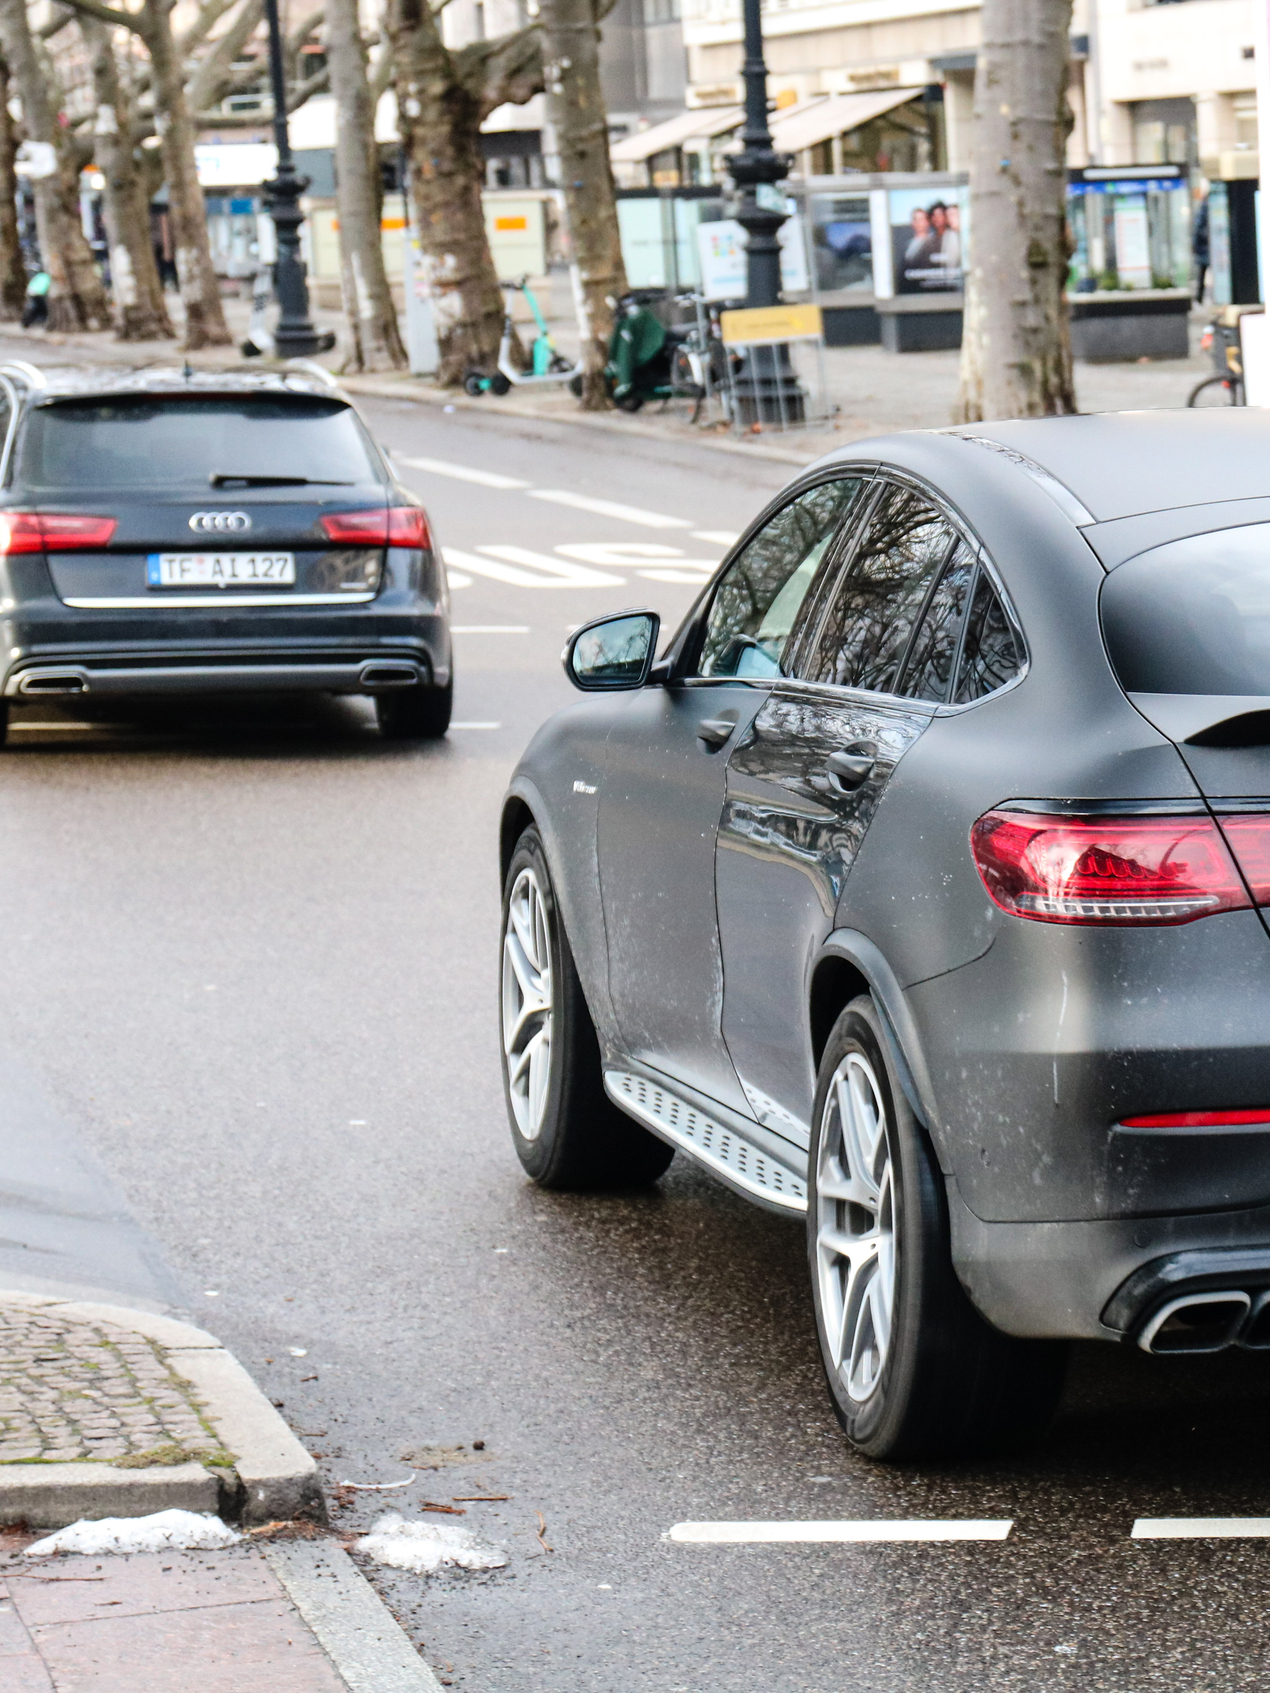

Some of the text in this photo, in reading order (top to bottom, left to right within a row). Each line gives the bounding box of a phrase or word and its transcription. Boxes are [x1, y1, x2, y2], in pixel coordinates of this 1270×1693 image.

[163, 557, 288, 578] TF AI 127
